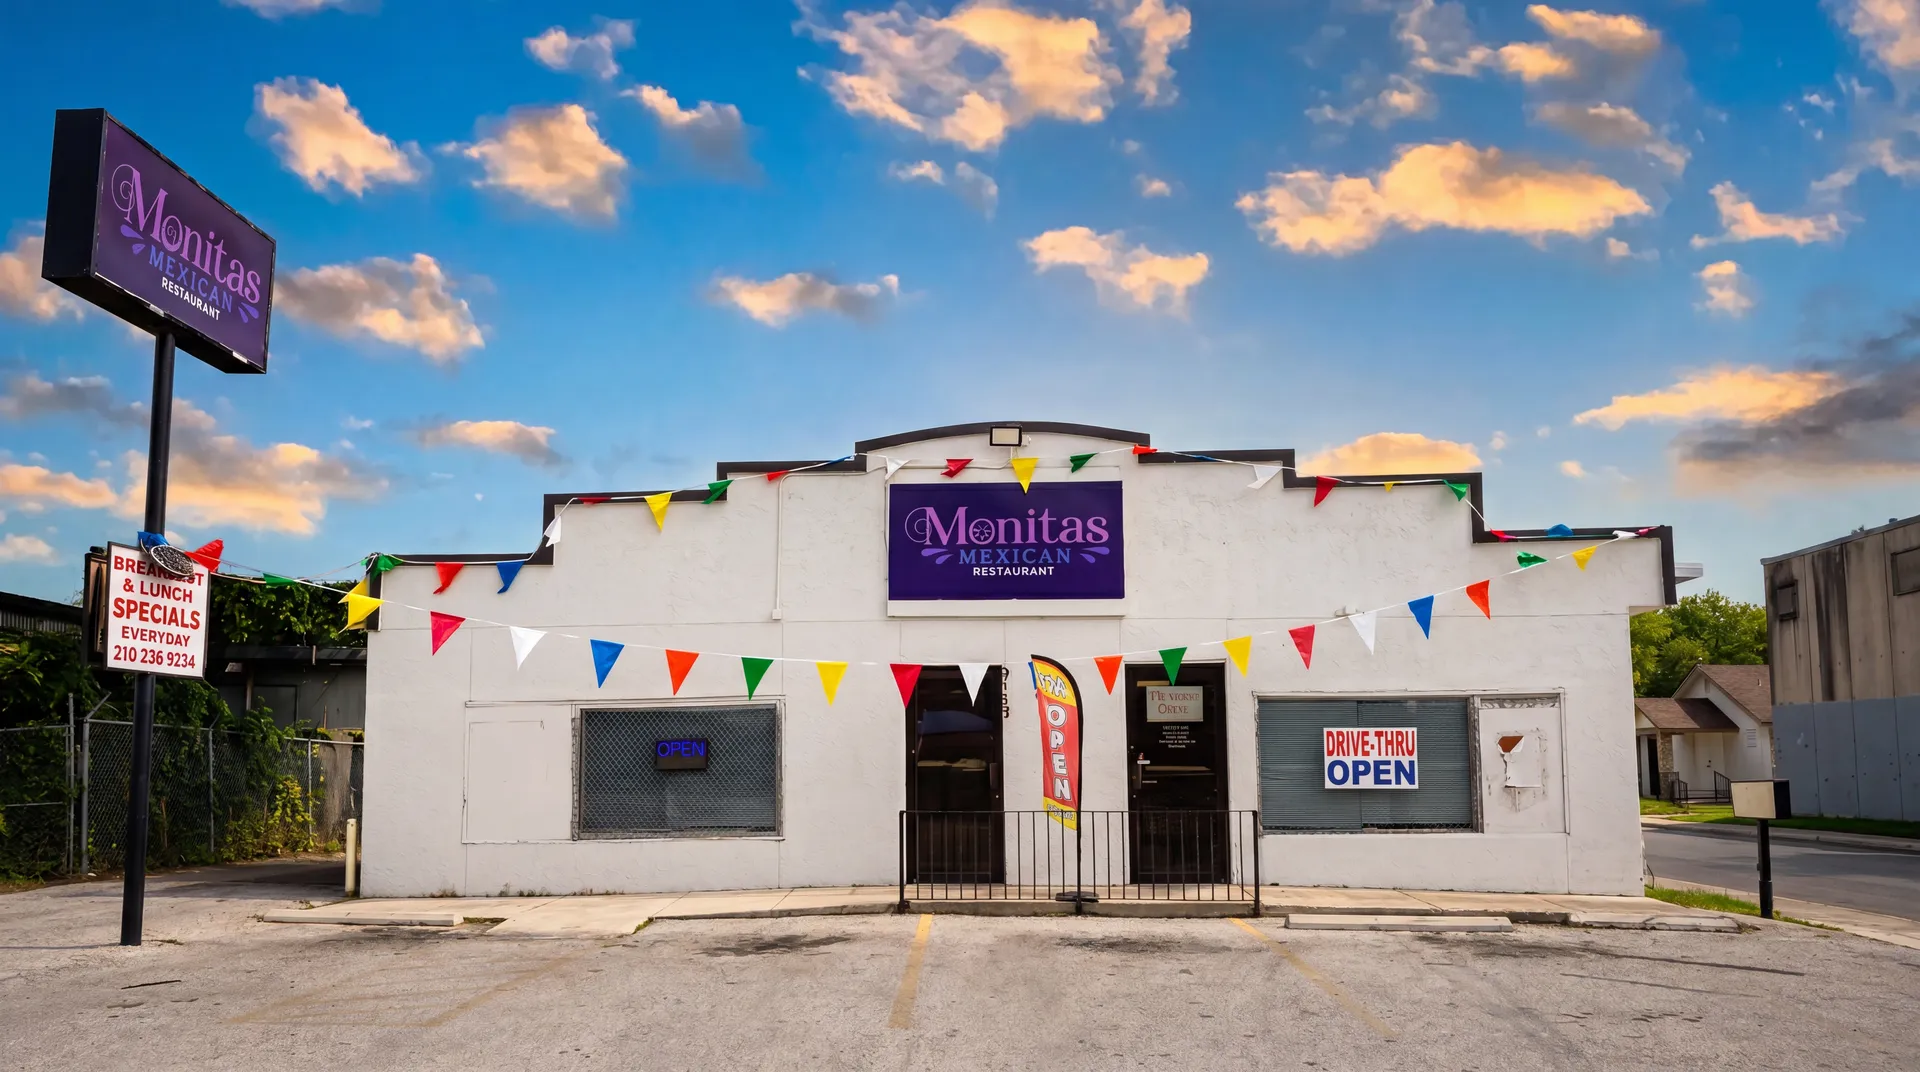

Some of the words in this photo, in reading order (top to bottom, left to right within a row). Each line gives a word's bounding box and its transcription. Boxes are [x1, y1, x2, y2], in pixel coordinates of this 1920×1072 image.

[112, 164, 260, 304] Monitas
[149, 244, 232, 313] MEXICAN
[162, 276, 220, 321] RESTAURANT
[905, 506, 1109, 546] Monitas
[958, 548, 1071, 565] MEXICAN
[973, 566, 1054, 577] RESTAURANT
[123, 578, 134, 593] &
[140, 580, 193, 603] LUNCH
[112, 597, 201, 630] SPECIALS
[121, 625, 191, 647] EVERYDAY
[113, 644, 137, 662] 210
[140, 648, 164, 665] 236
[166, 651, 195, 668] 9234
[657, 741, 705, 757] OPEN
[1046, 703, 1072, 801] OPEN
[1326, 730, 1415, 756] DRIVE-THRU
[1327, 760, 1416, 785] OPEN
